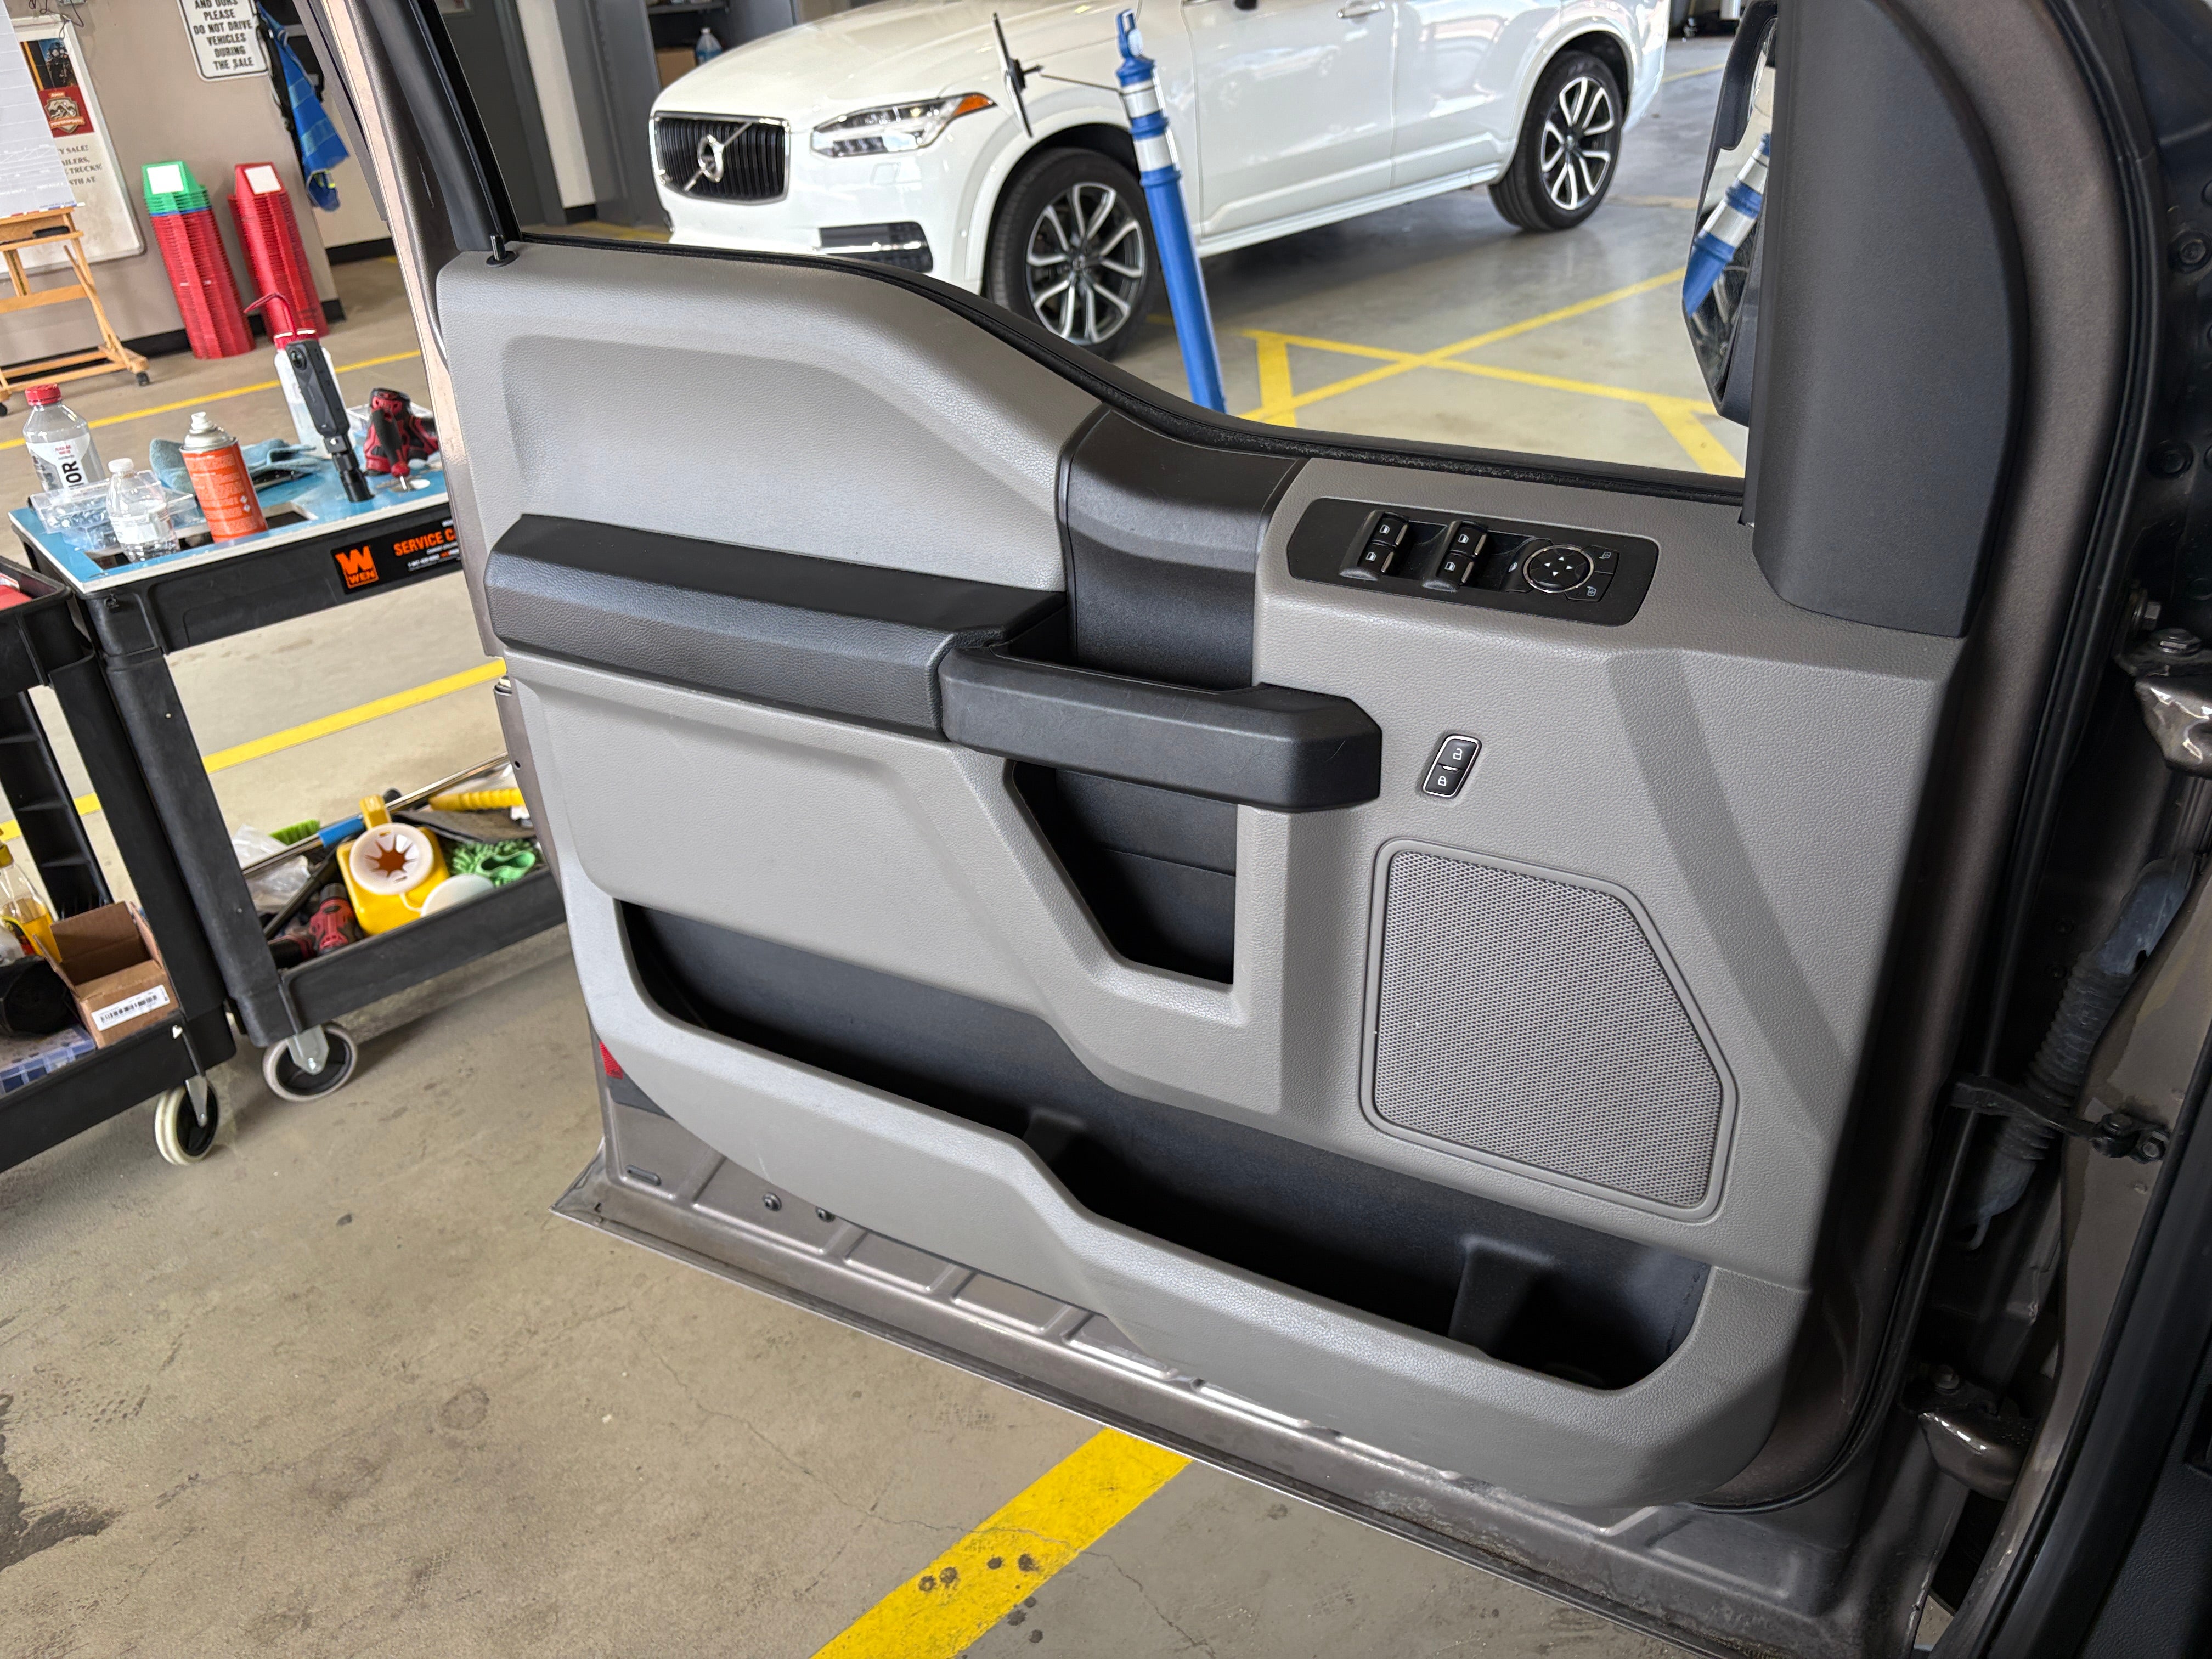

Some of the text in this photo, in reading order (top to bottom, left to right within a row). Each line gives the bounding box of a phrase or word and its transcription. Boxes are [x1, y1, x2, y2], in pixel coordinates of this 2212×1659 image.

[195, 0, 212, 9] AND
[203, 9, 236, 21] PLEASE
[193, 20, 252, 34] DO NOT DRIVE
[206, 33, 246, 46] VEHICLES
[214, 46, 246, 57] DURING
[213, 57, 254, 70] THE SALE
[393, 531, 444, 557] SERVICE
[348, 571, 376, 584] WEN
